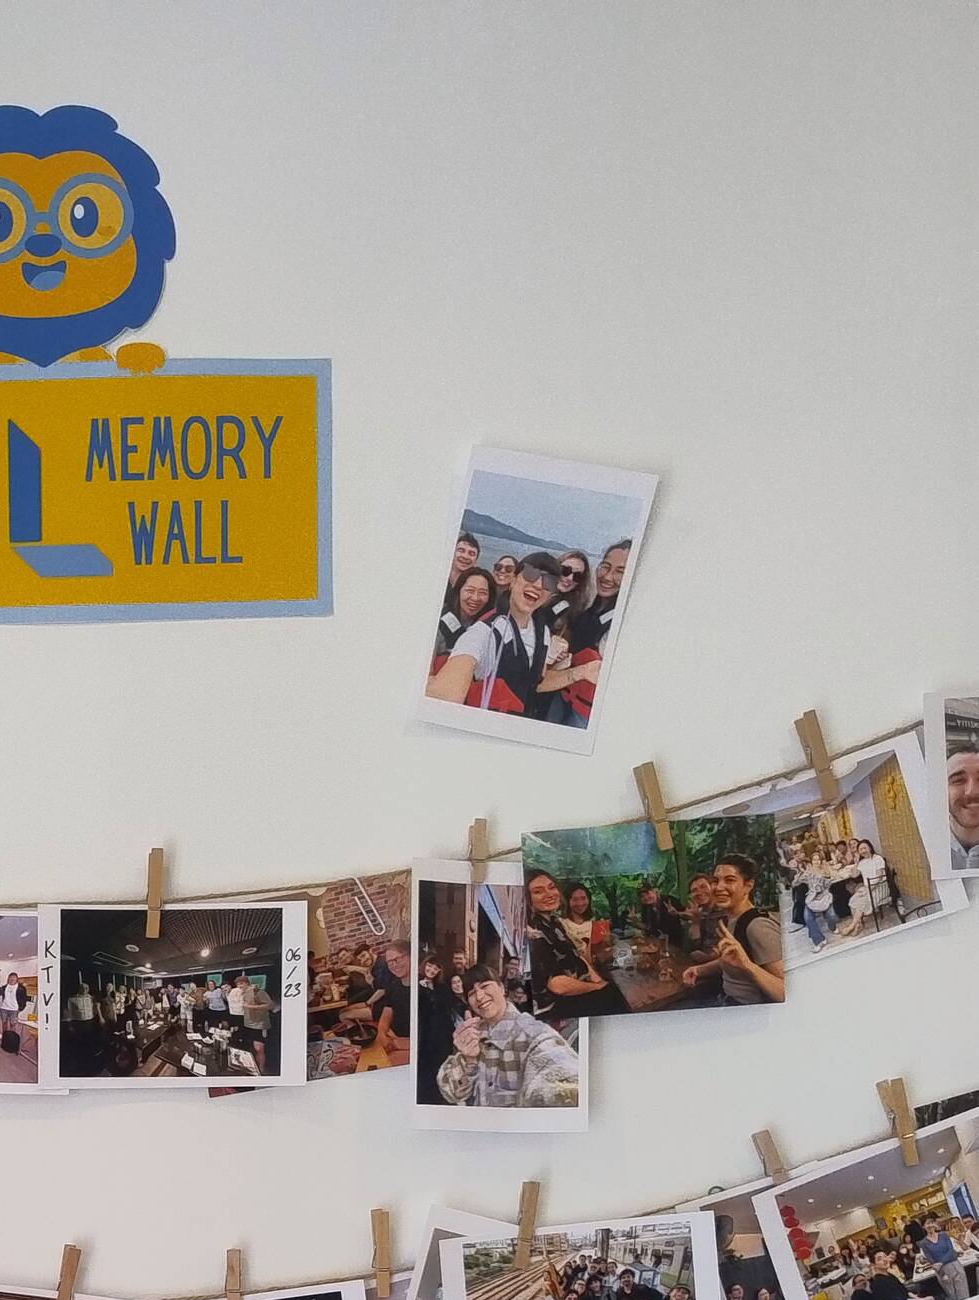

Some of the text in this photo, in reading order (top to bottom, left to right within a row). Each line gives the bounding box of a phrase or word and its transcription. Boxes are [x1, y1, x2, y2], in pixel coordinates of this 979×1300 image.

[85, 415, 283, 482] MEMORY
[127, 500, 243, 566] WALL
[41, 940, 56, 1030] KTV!
[284, 947, 301, 998] 06/23
